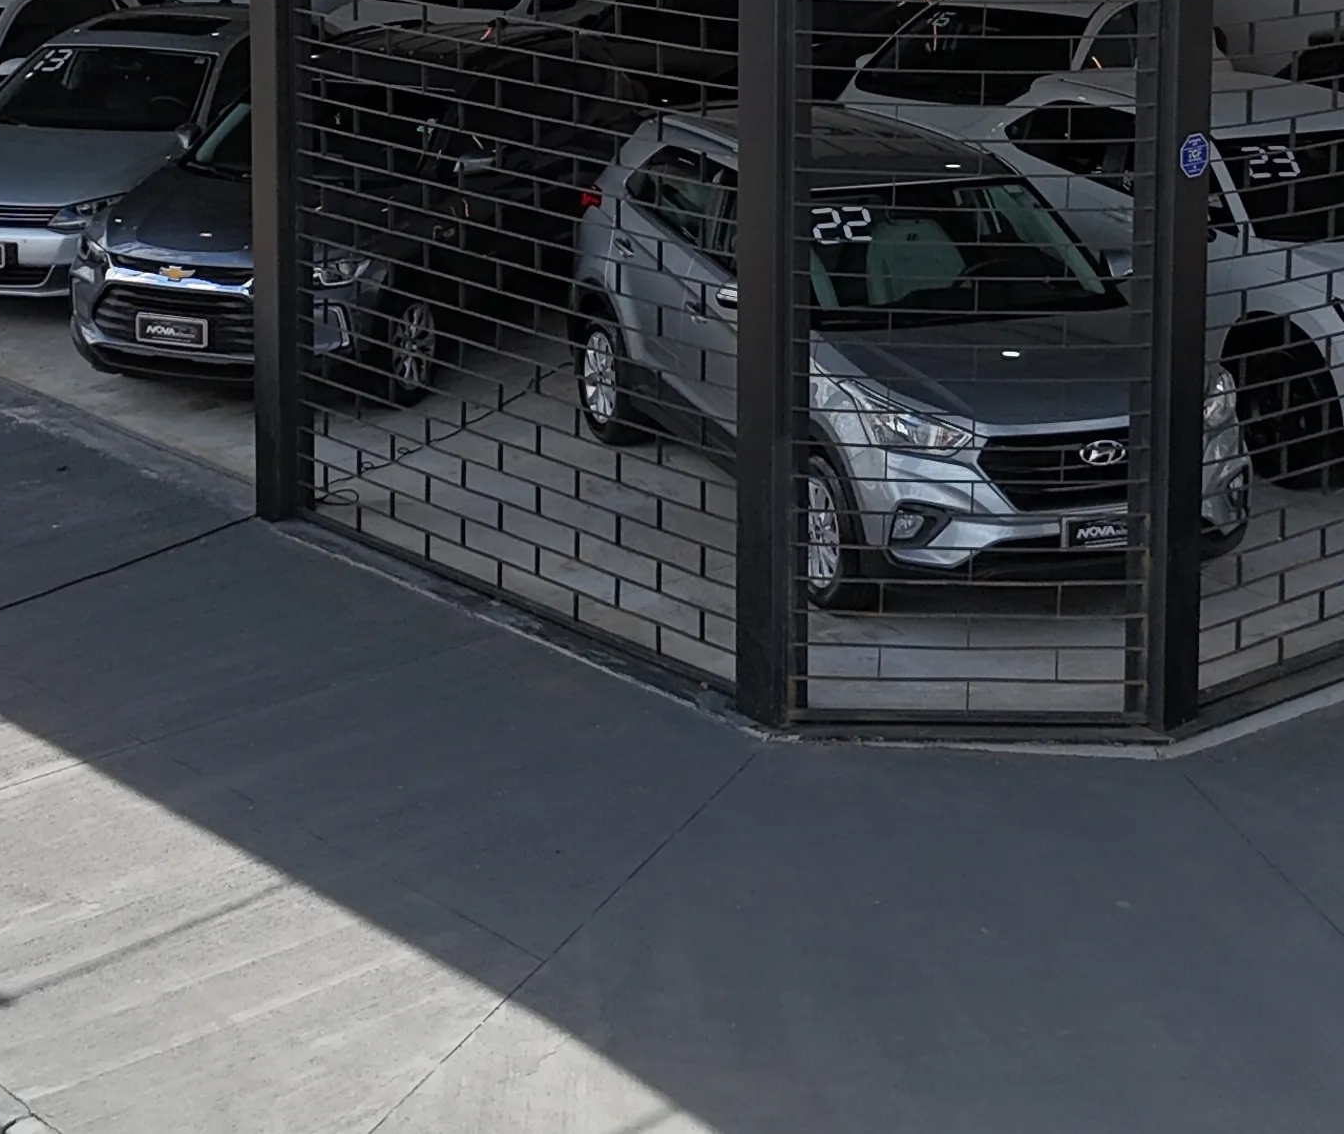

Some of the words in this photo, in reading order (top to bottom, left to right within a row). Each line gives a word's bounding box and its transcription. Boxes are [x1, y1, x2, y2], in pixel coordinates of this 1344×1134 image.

[1240, 145, 1301, 179] 23
[811, 206, 873, 245] 22
[146, 325, 176, 336] NOVA
[1076, 525, 1116, 539] NOVA
